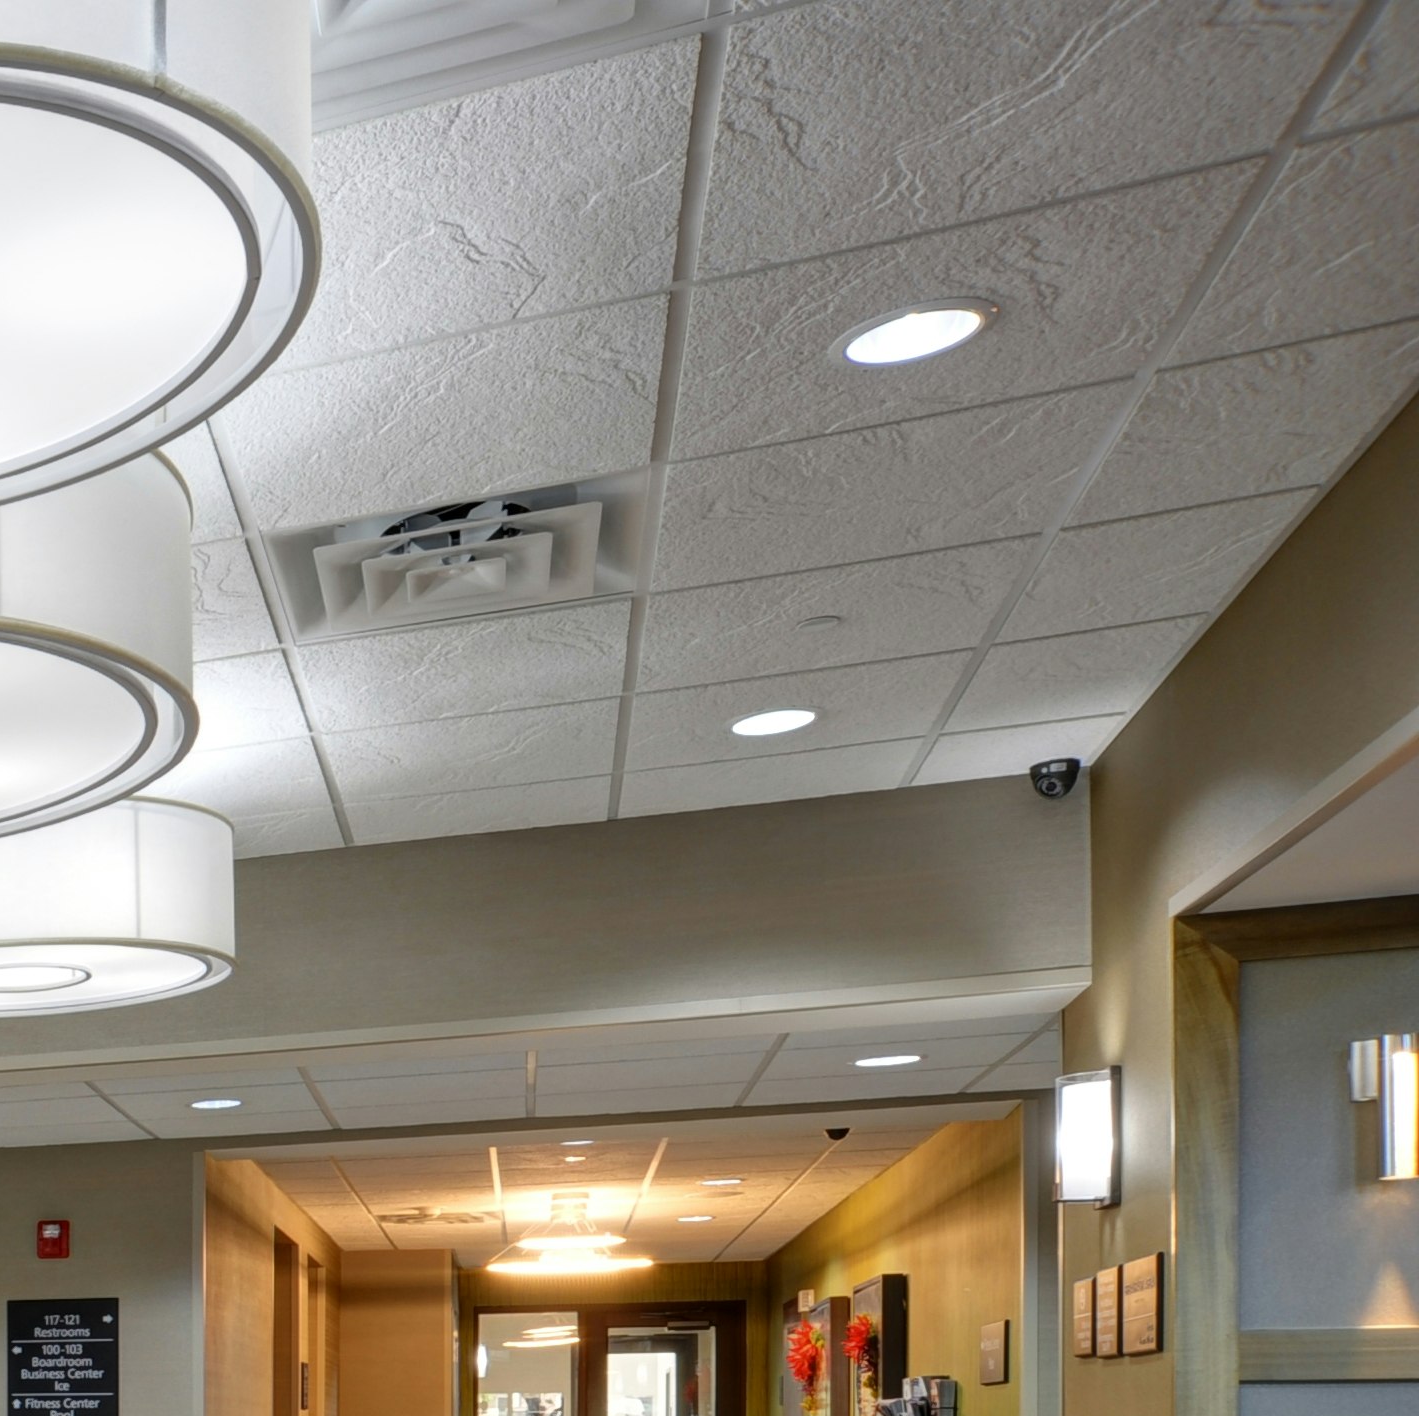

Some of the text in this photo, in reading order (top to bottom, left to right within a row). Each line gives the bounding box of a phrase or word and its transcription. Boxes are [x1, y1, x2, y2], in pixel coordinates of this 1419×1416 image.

[44, 1315, 81, 1326] 117-121
[34, 1327, 91, 1338] Restrooms
[42, 1344, 83, 1356] 100-103
[31, 1356, 93, 1368] Boardroom
[20, 1368, 104, 1379] Business Center
[54, 1381, 71, 1391] Ice
[24, 1397, 101, 1409] Fitness Center
